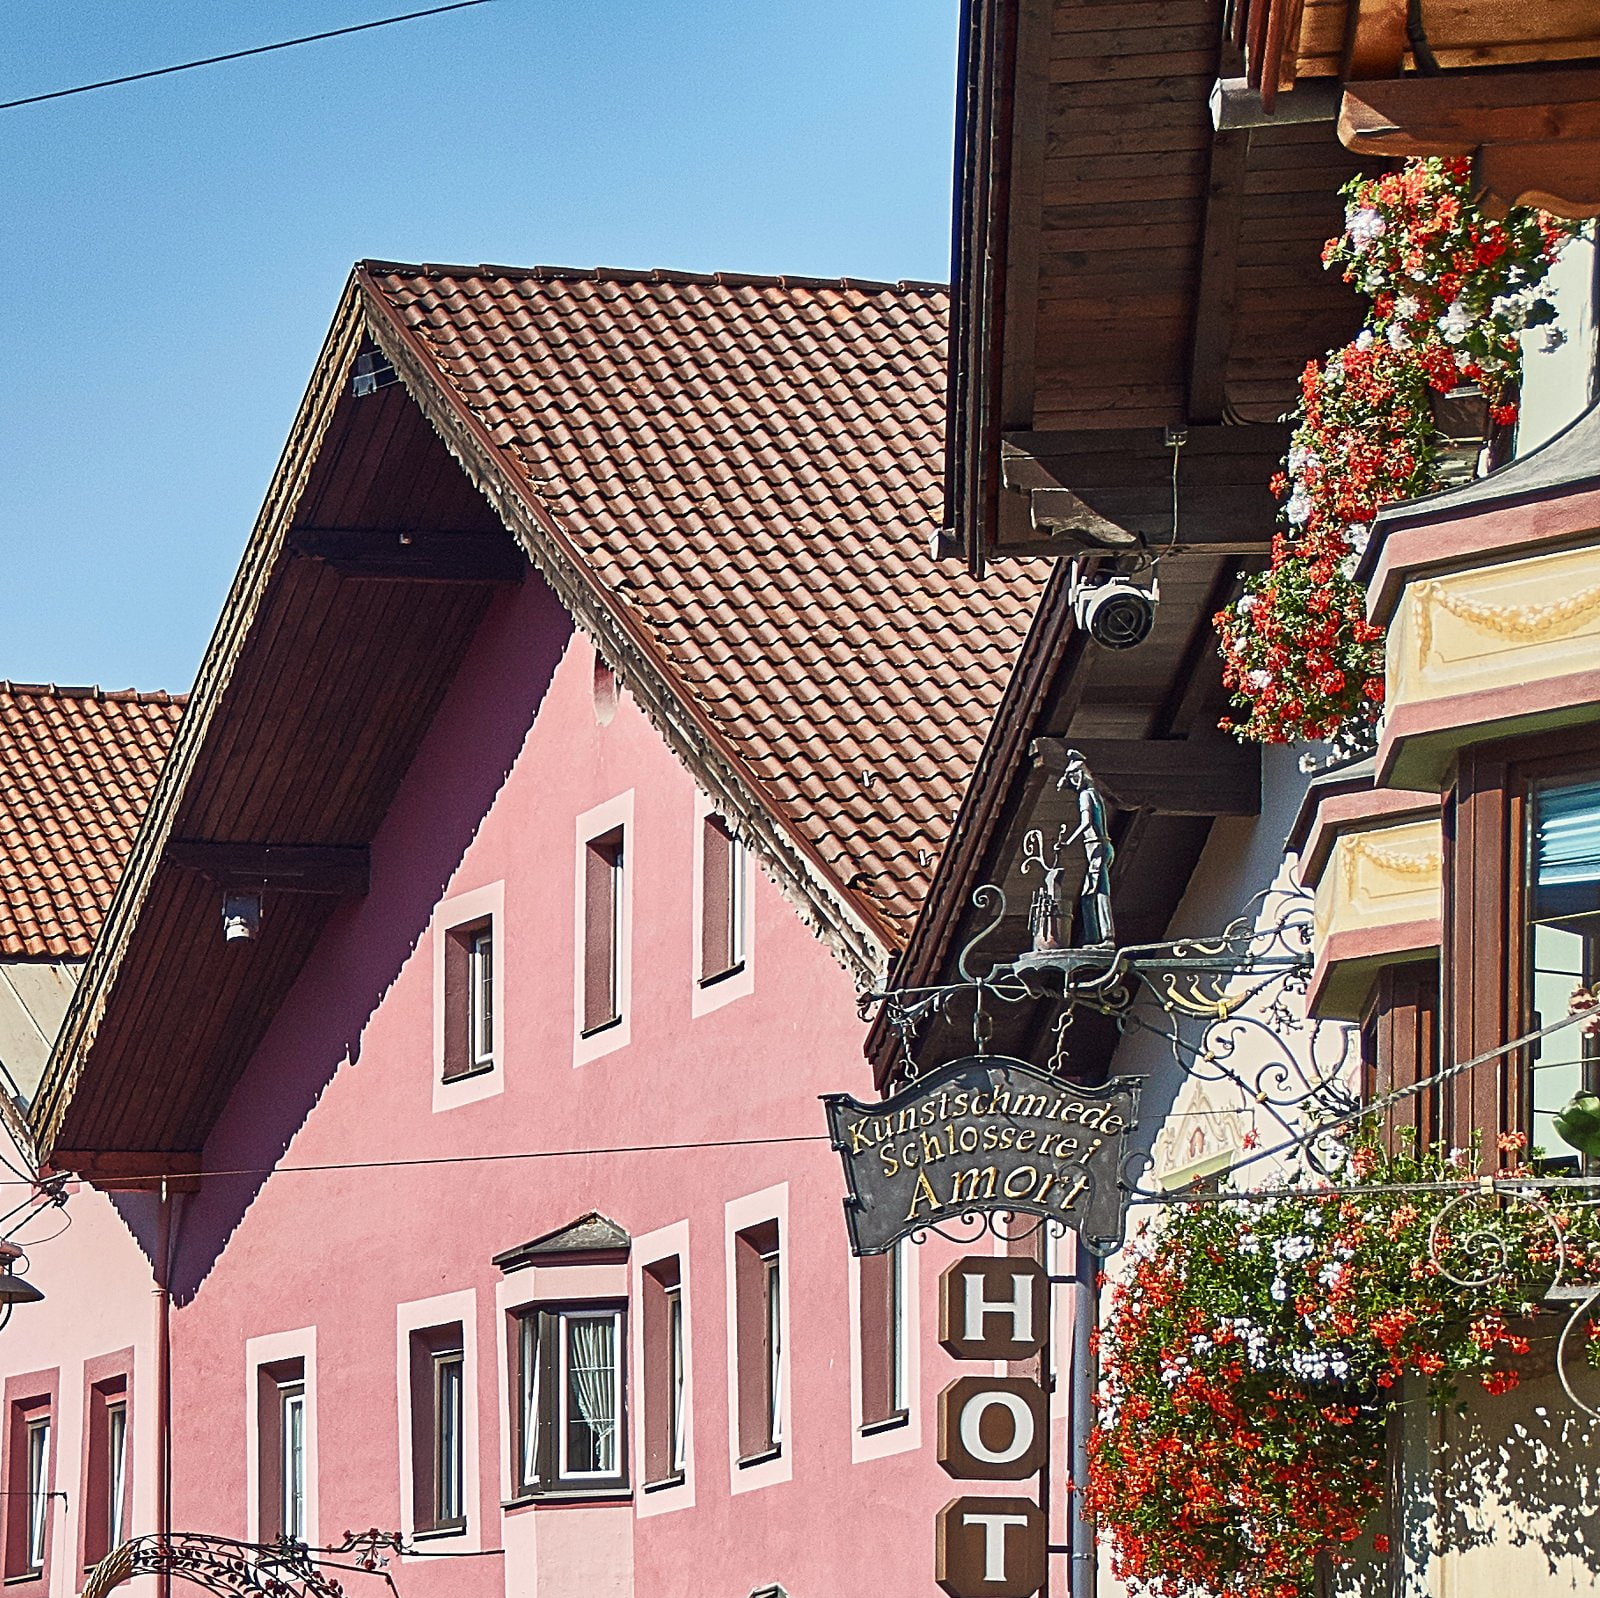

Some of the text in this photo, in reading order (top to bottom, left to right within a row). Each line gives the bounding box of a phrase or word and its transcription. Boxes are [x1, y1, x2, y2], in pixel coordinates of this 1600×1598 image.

[847, 1084, 1127, 1155] Kunstschmiede
[879, 1123, 1102, 1178] Schlosserei
[903, 1164, 1091, 1222] Amort
